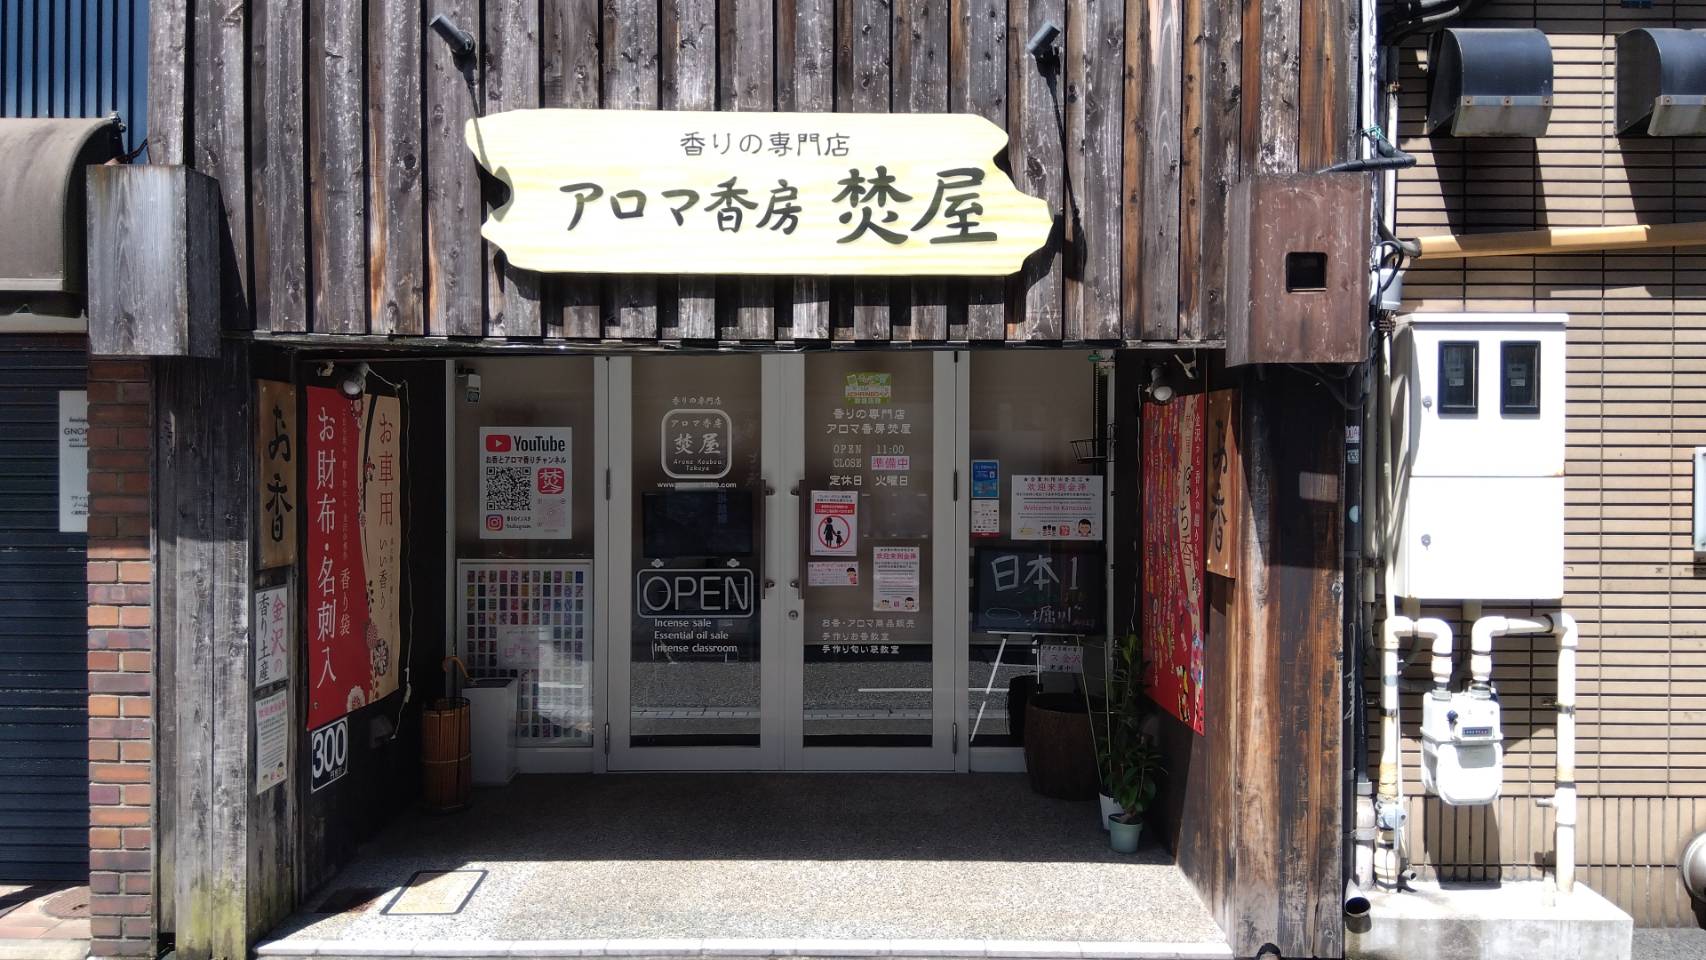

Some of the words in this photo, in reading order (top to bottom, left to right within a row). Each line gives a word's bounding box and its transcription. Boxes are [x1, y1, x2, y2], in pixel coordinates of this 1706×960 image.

[679, 131, 851, 158] 香りの専門店
[559, 177, 802, 235] アロマ香房
[831, 165, 998, 245] 焚屋
[832, 408, 906, 420] 香りの専門店
[513, 435, 565, 452] YouTube
[833, 444, 862, 454] OPEN
[876, 444, 905, 454] 11:00
[832, 457, 862, 468] CLOSE
[266, 406, 293, 543] お香
[829, 475, 862, 486] 定休日
[875, 475, 908, 486] 火曜日
[316, 406, 337, 690] お財布・名刺入
[643, 575, 749, 612] OPEN
[654, 618, 689, 628] Incense
[693, 618, 712, 628] sale
[654, 631, 694, 641] Essential
[696, 631, 708, 641] oil
[710, 631, 729, 641] sale
[654, 643, 689, 653] Incense
[692, 643, 738, 653] classroom
[313, 722, 347, 779] 300
